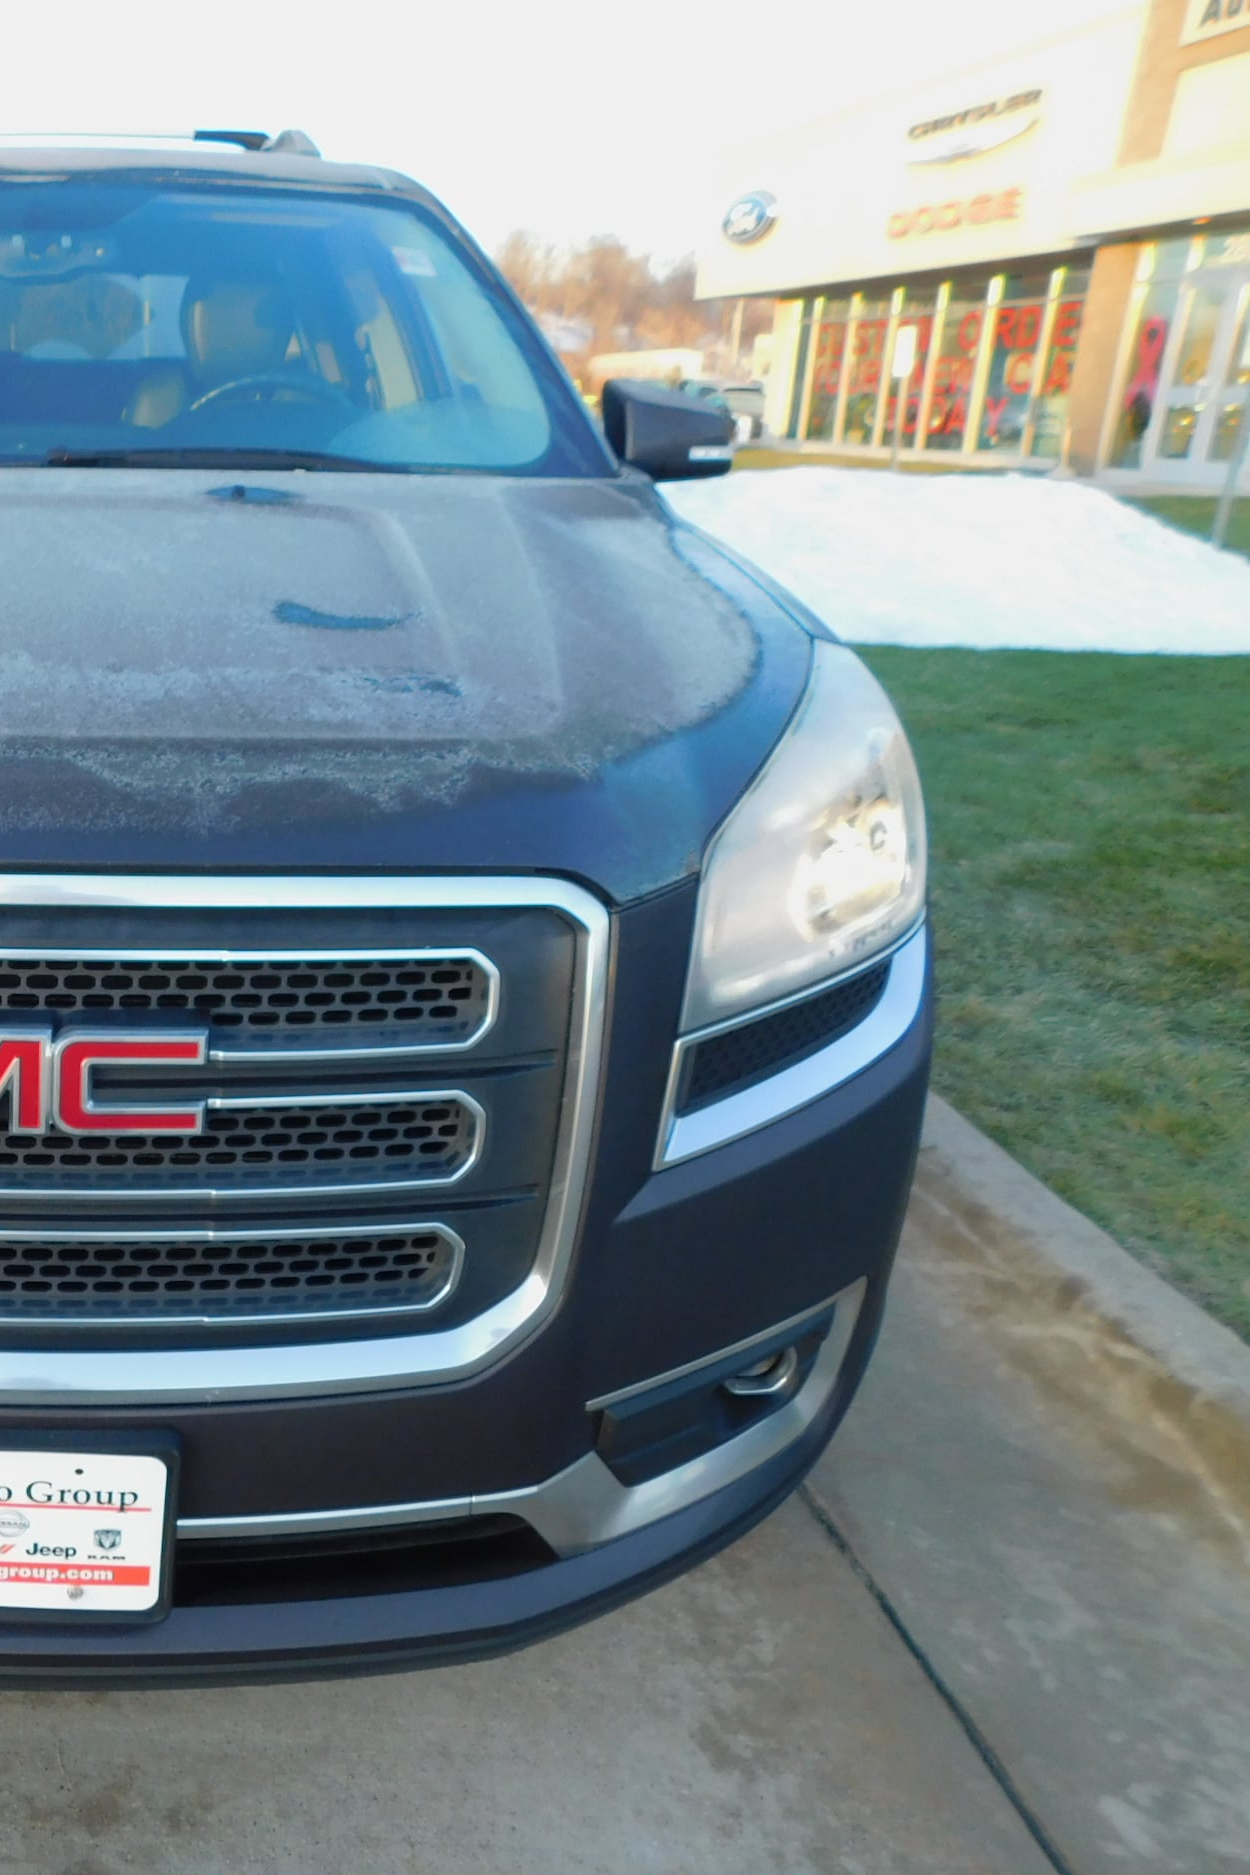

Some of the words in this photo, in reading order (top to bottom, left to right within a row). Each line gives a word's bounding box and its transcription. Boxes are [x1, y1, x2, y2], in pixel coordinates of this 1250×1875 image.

[887, 187, 1022, 238] DODGE
[958, 301, 1083, 351] ORDE
[1004, 350, 1073, 396] CA
[25, 1480, 139, 1513] Group
[25, 1542, 77, 1560] Jeep
